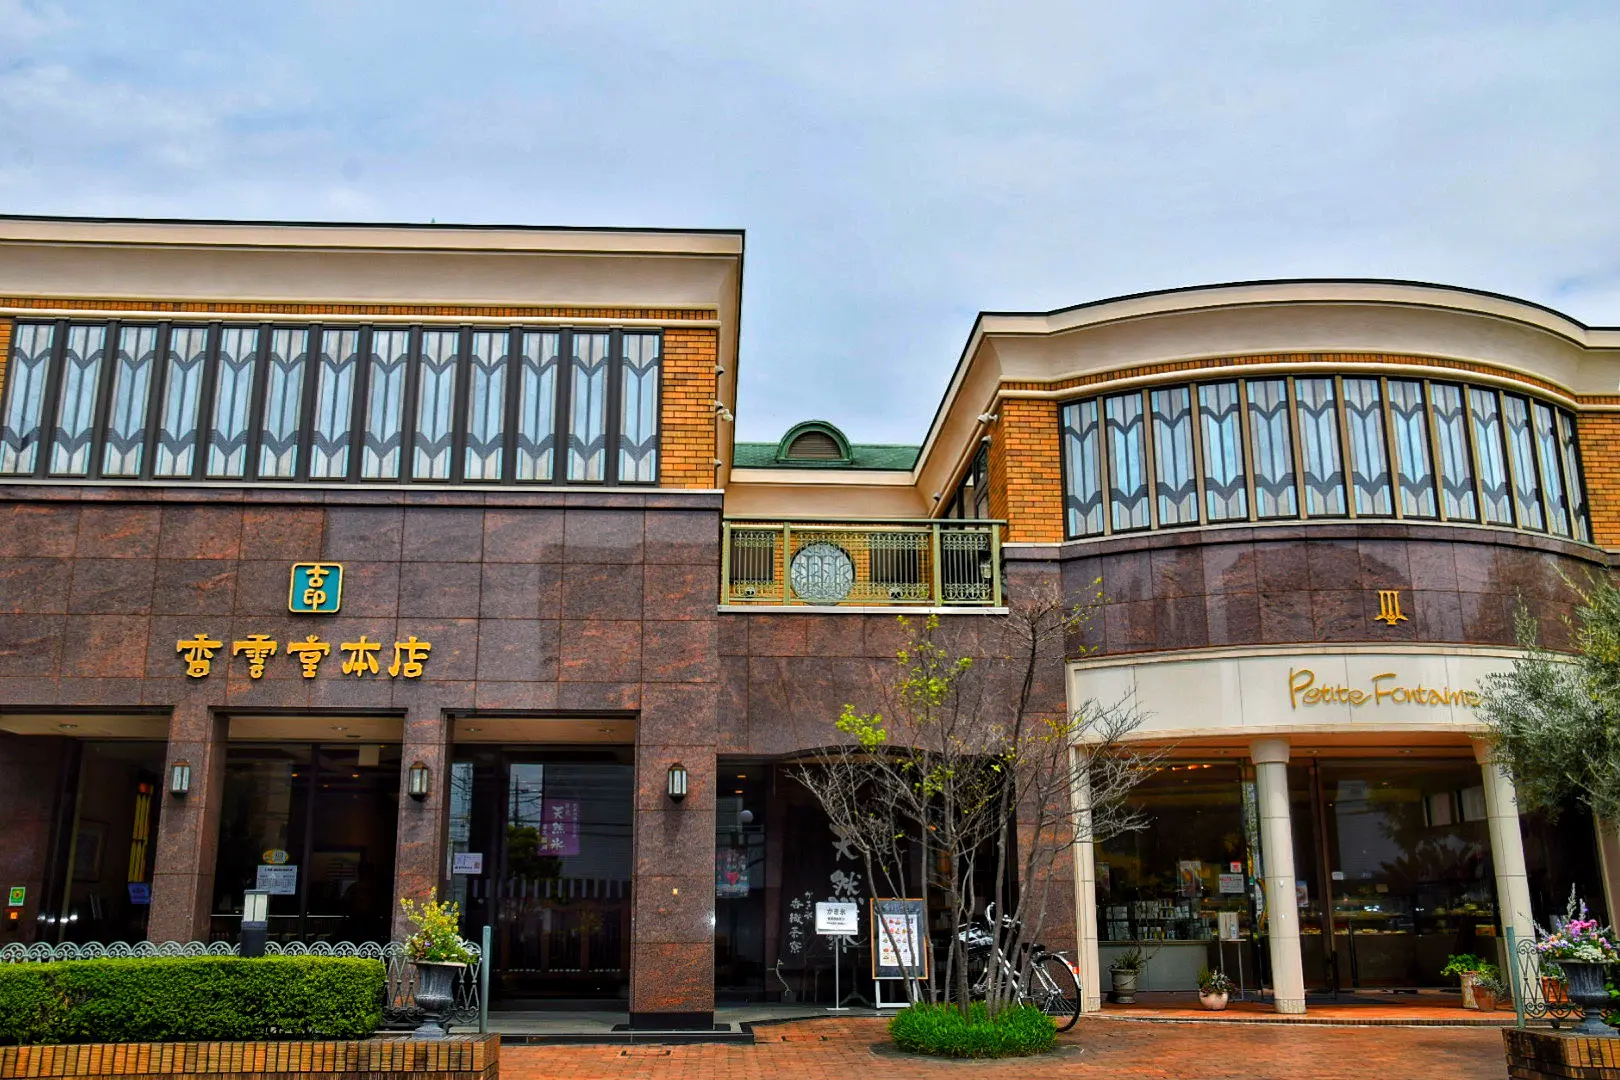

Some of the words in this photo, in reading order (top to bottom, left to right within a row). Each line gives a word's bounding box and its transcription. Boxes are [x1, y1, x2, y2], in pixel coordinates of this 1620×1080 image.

[303, 565, 330, 611] 古印
[176, 633, 432, 679] 香雲堂本店
[1288, 667, 1371, 709] Petite
